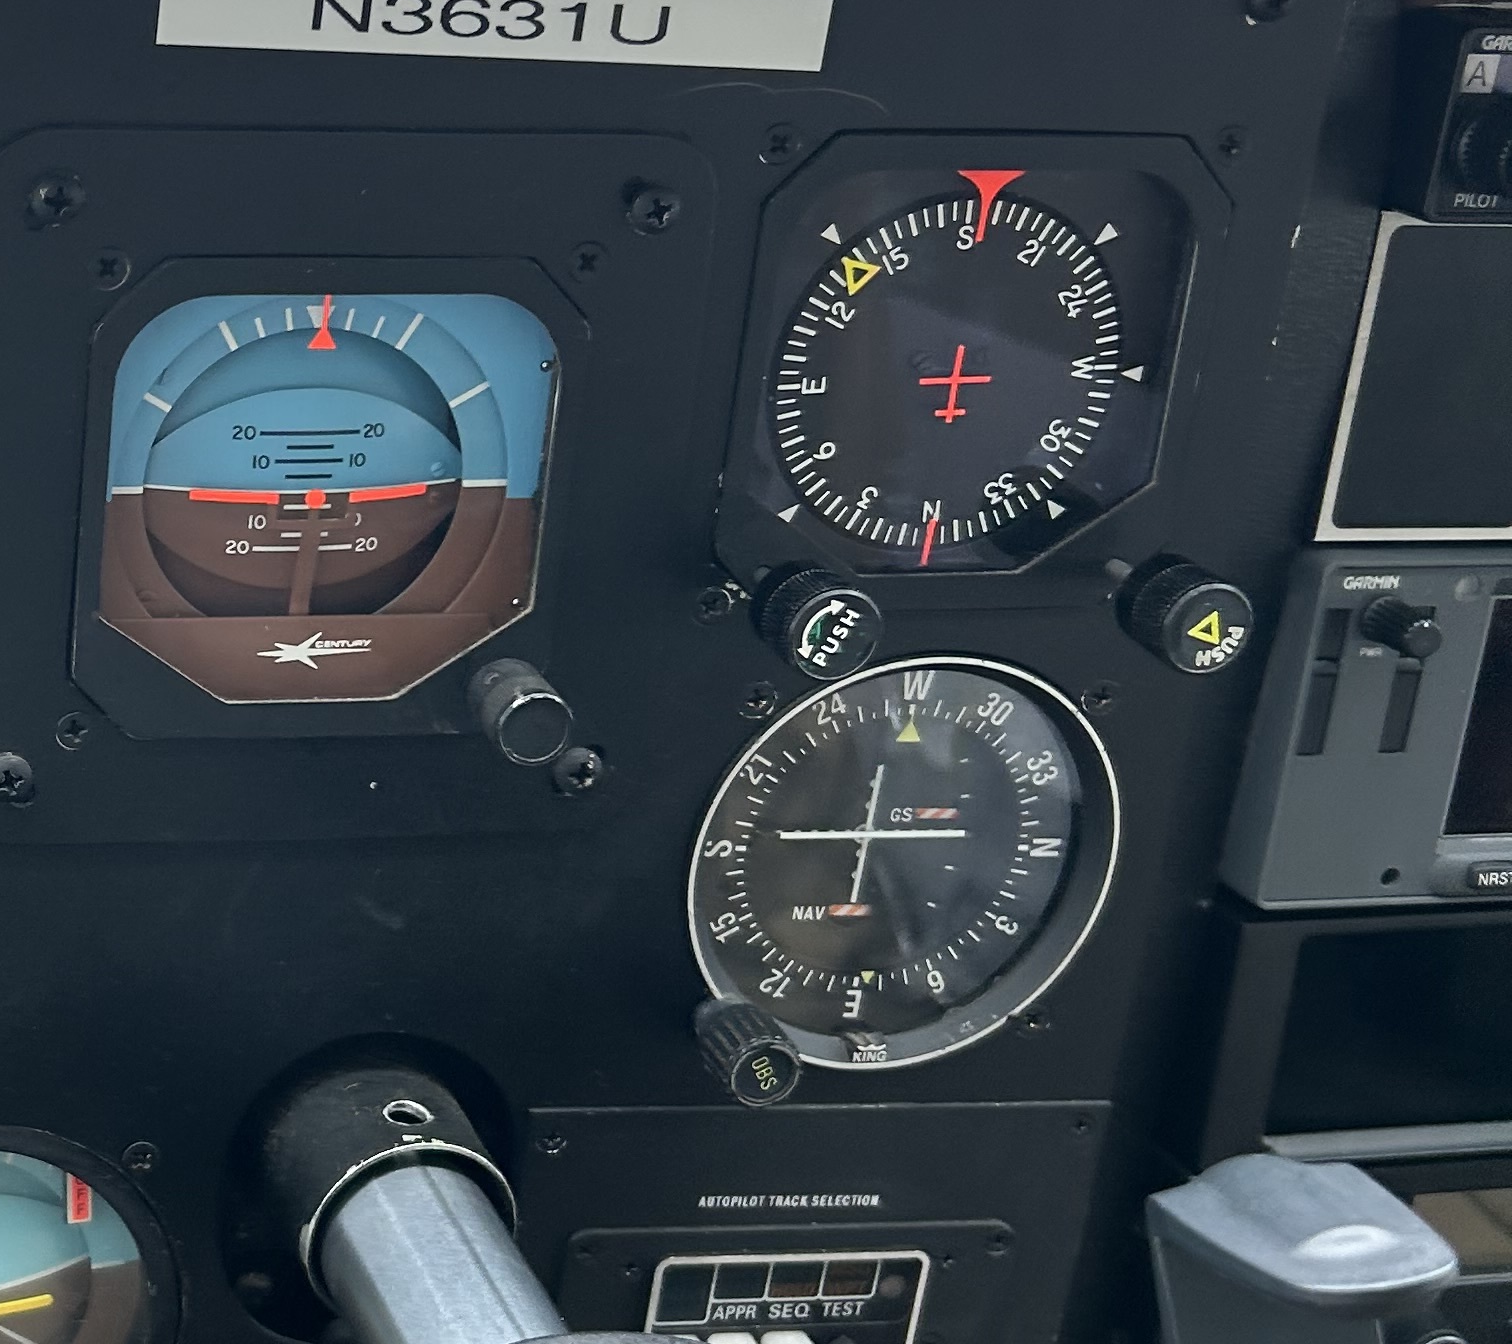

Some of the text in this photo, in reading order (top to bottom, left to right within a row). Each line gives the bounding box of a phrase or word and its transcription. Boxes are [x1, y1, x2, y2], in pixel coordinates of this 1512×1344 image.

[1467, 60, 1486, 87] A
[957, 225, 976, 250] S
[881, 246, 910, 276] 15
[1016, 239, 1047, 269] 21
[1057, 283, 1088, 319] 24
[824, 299, 856, 330] 12
[1070, 356, 1094, 380] W
[800, 375, 828, 395] E
[231, 422, 386, 441] 20 20
[1040, 418, 1074, 452] 30
[251, 452, 367, 471] 10 10
[857, 486, 879, 509] 3
[983, 472, 1017, 503] 33
[247, 514, 267, 530] 10
[922, 500, 942, 522] N
[225, 536, 378, 555] 20 20
[1343, 575, 1400, 589] GARMIN
[315, 639, 372, 648] CENTURY
[812, 607, 861, 668] PUSH
[1194, 625, 1245, 667] PUSH
[903, 670, 936, 701] W
[812, 693, 847, 726] 24
[977, 692, 1015, 727] 30
[1025, 750, 1058, 787] 33
[890, 807, 913, 823] GS
[704, 840, 734, 859] S
[1029, 836, 1064, 858] N
[792, 906, 826, 921] NAV
[994, 915, 1019, 936] 3
[709, 911, 743, 944] 15
[758, 968, 792, 1000] 12
[842, 989, 863, 1019] E
[852, 1051, 888, 1062] KING
[750, 1056, 778, 1092] OBS
[698, 1194, 879, 1207] AUTOPILOT TRACK SELECTION
[712, 1301, 865, 1320] APPR SEQ TEST
